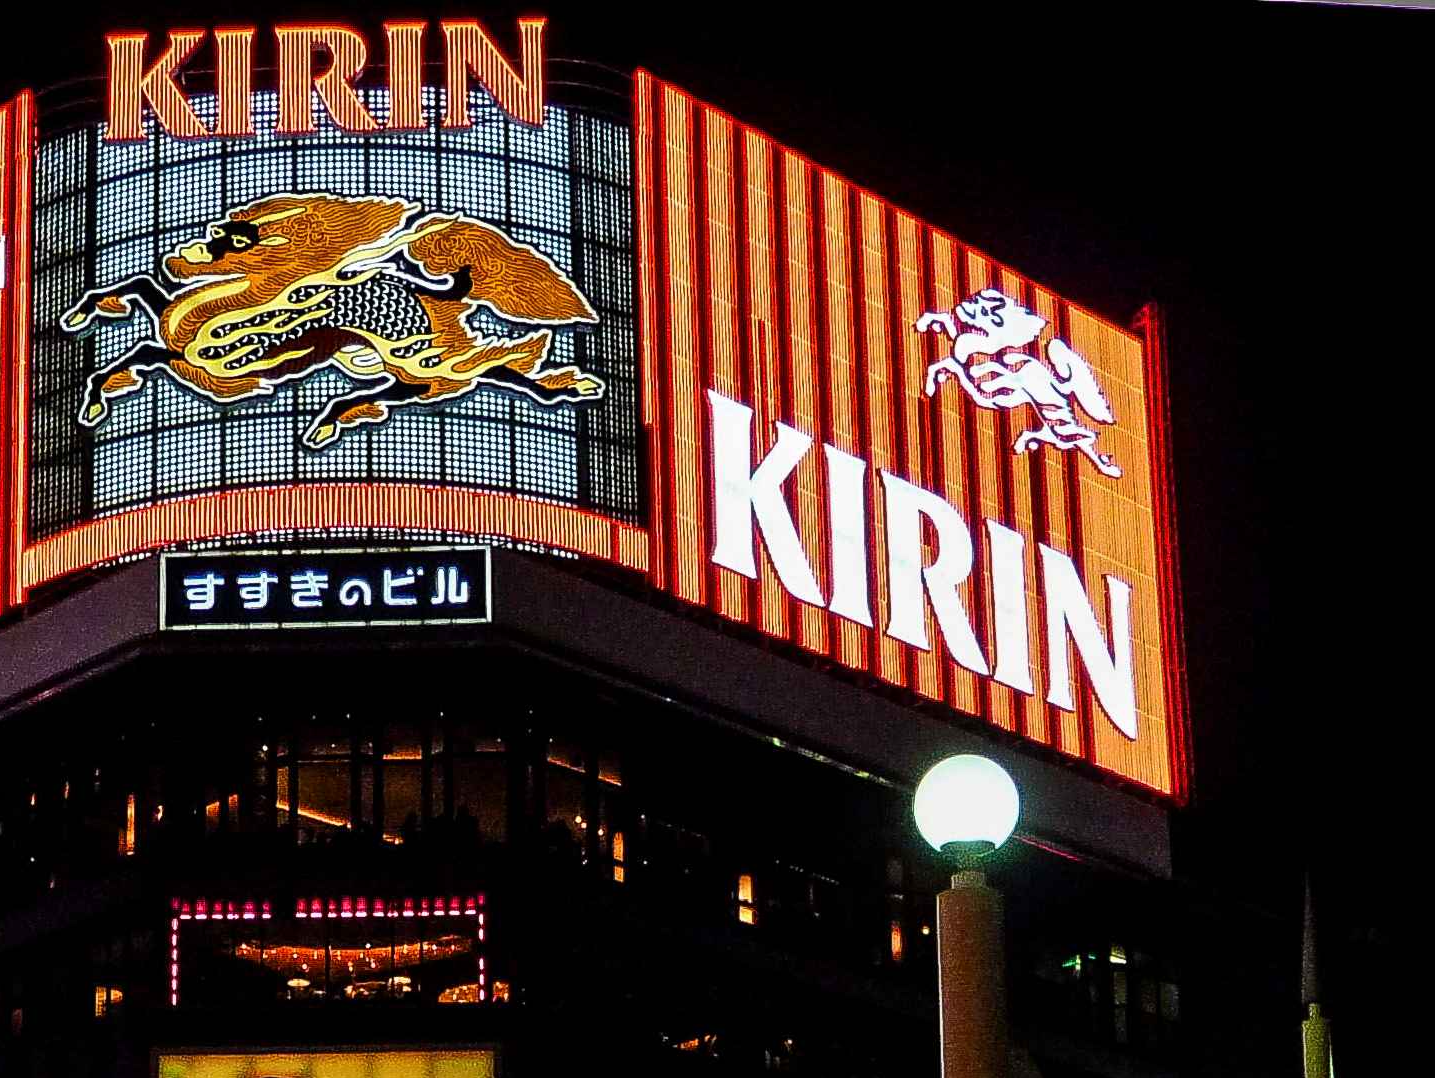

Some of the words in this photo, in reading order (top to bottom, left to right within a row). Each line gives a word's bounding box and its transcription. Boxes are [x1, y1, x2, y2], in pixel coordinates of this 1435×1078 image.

[103, 16, 549, 141] KIRIN
[183, 566, 470, 611] すすきのビル
[708, 388, 1137, 742] KIRIN
